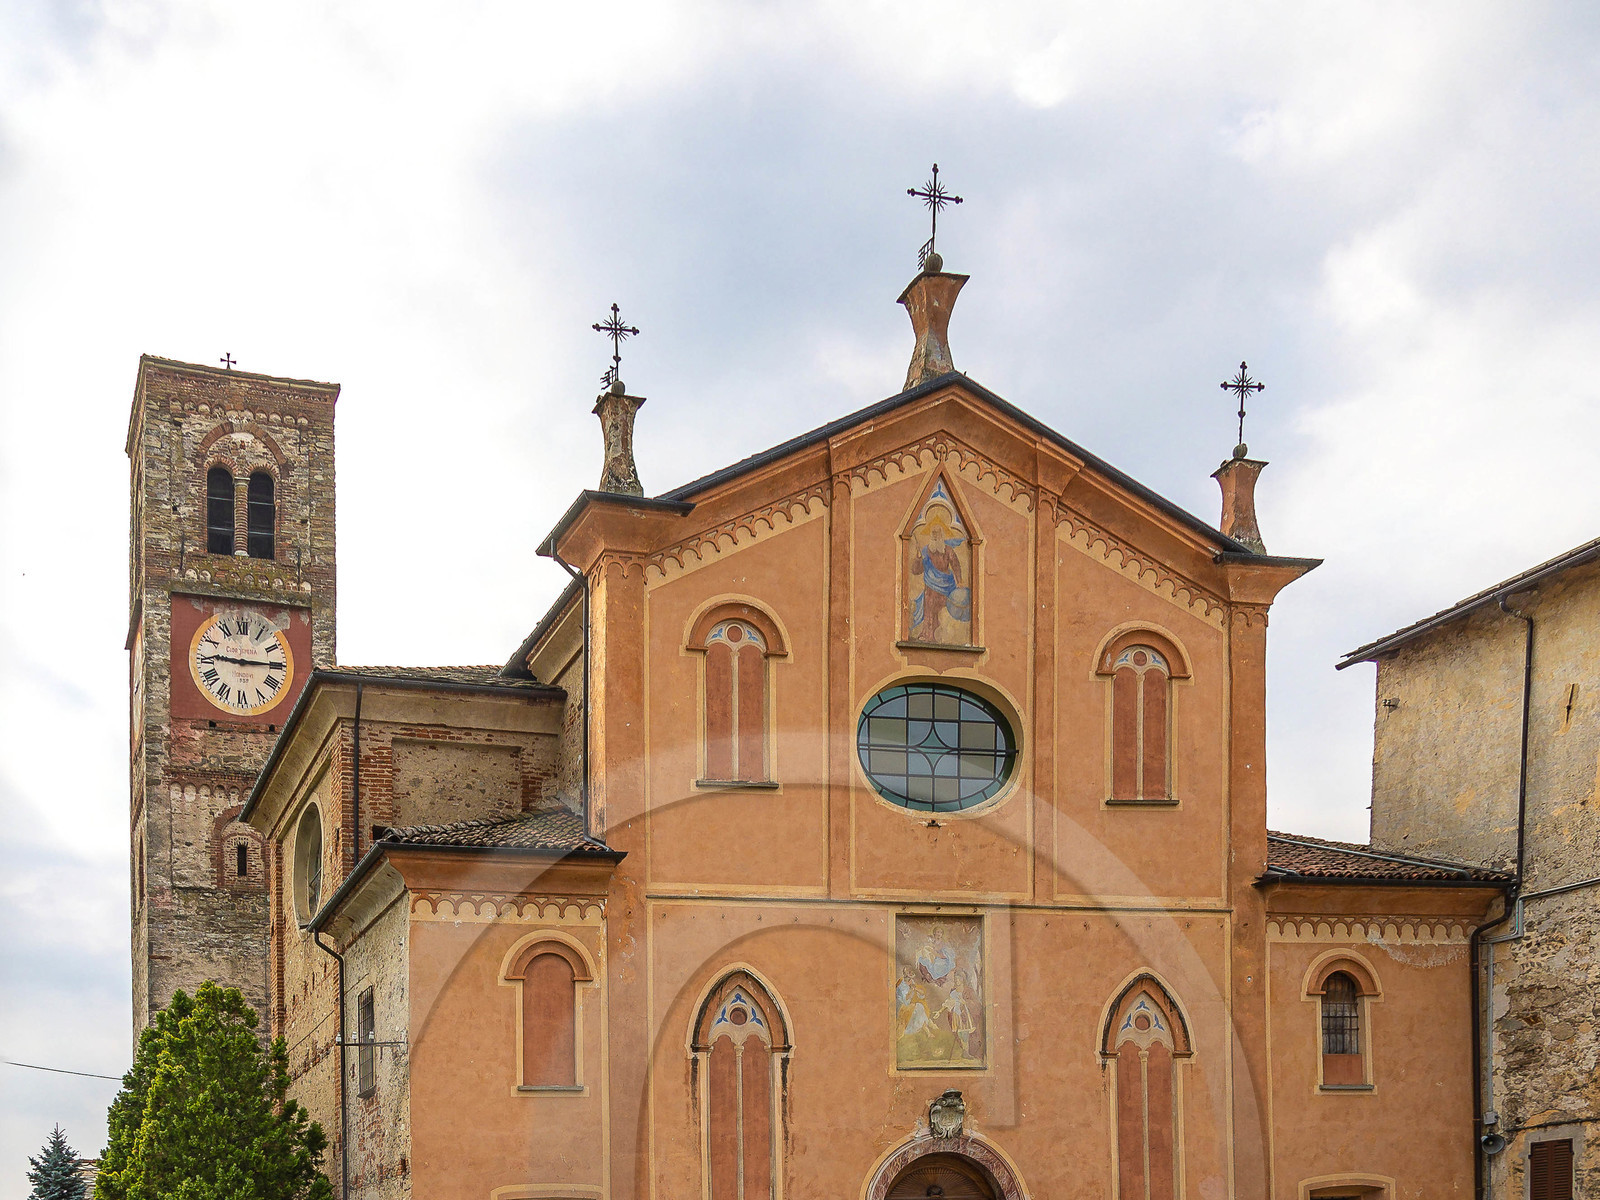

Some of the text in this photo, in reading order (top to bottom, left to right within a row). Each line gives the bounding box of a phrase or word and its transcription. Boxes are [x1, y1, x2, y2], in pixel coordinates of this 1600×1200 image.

[218, 623, 232, 639] XI
[236, 621, 248, 636] XII
[205, 636, 220, 648] X
[265, 643, 278, 653] II
[203, 668, 220, 686] VIII
[217, 682, 231, 700] VII
[237, 690, 248, 704] VI
